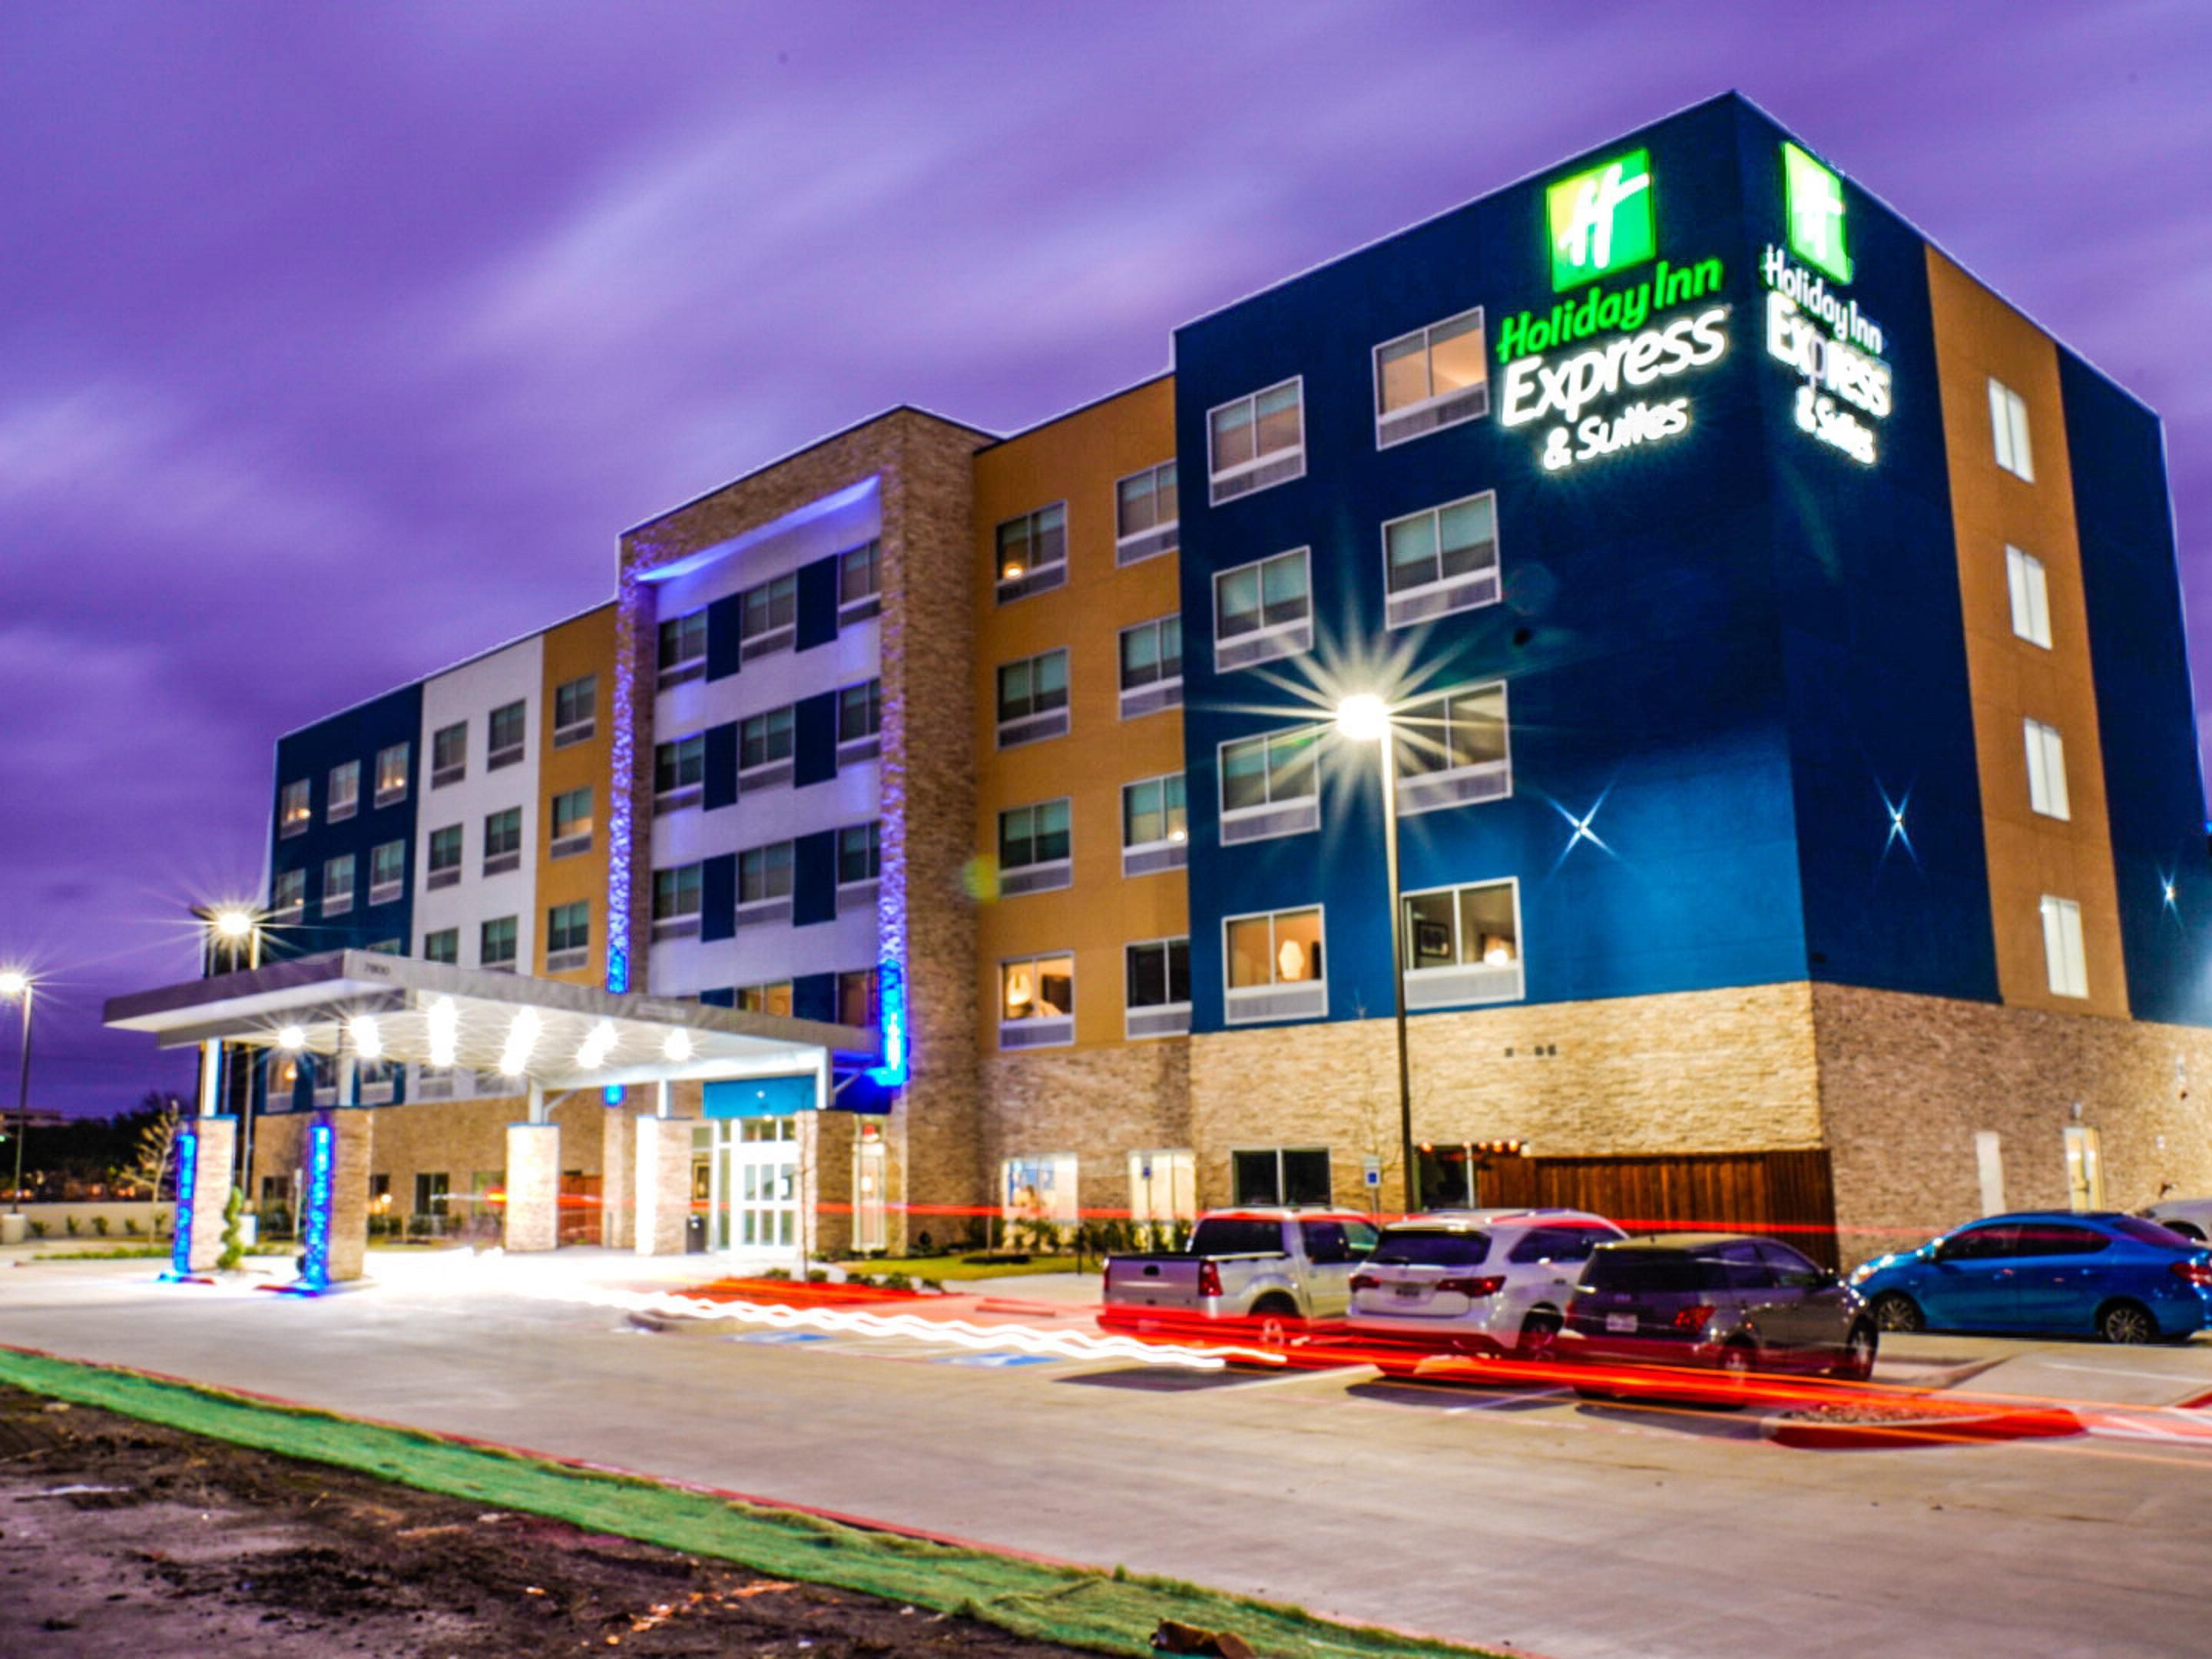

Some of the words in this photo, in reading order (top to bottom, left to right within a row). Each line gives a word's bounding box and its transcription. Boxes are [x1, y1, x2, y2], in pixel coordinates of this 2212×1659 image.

[1496, 282, 1651, 364] Holiday
[1654, 257, 1724, 309] Inn
[1764, 243, 1848, 340] Holiday
[1849, 300, 1883, 355] Inn
[1767, 290, 1892, 419] Express
[1502, 308, 1730, 427] Express
[1543, 426, 1572, 471] &
[1575, 398, 1689, 461] Suites
